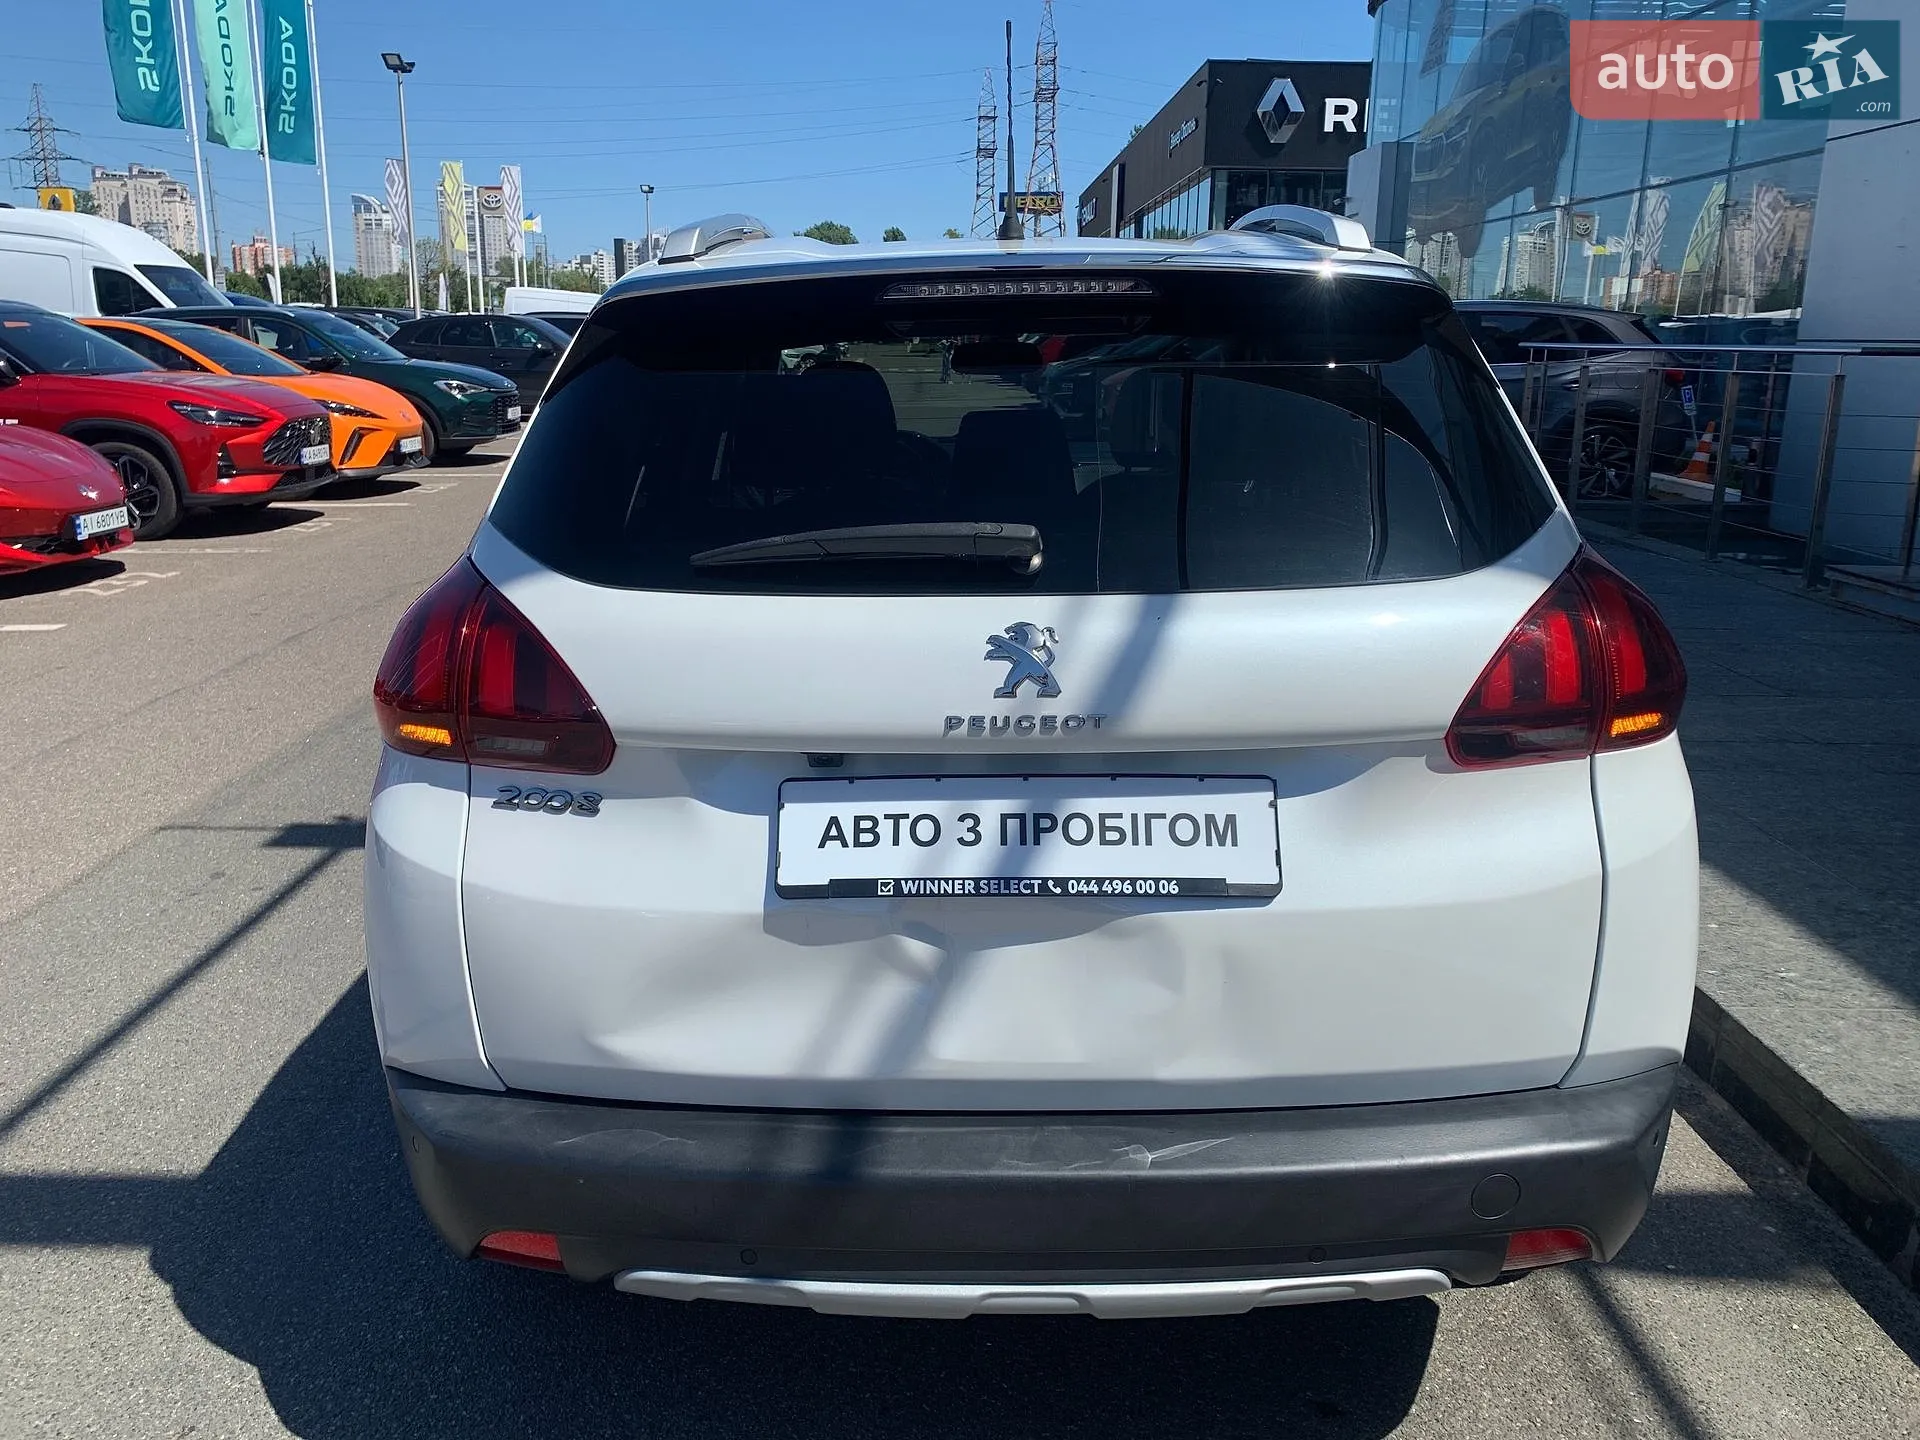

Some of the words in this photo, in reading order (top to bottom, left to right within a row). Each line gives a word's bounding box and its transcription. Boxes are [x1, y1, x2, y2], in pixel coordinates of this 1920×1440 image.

[1324, 97, 1369, 132] R
[942, 714, 1107, 738] PEUGEOT
[491, 784, 604, 818] 2008
[817, 814, 942, 849] АВТО
[999, 812, 1239, 849] ПРОБІГОМ
[900, 879, 974, 895] WINNER
[979, 879, 1041, 895] SELECT
[1067, 879, 1099, 895] 044
[1102, 879, 1132, 895] 496
[1135, 879, 1155, 895] 00
[1158, 879, 1179, 895] 06
